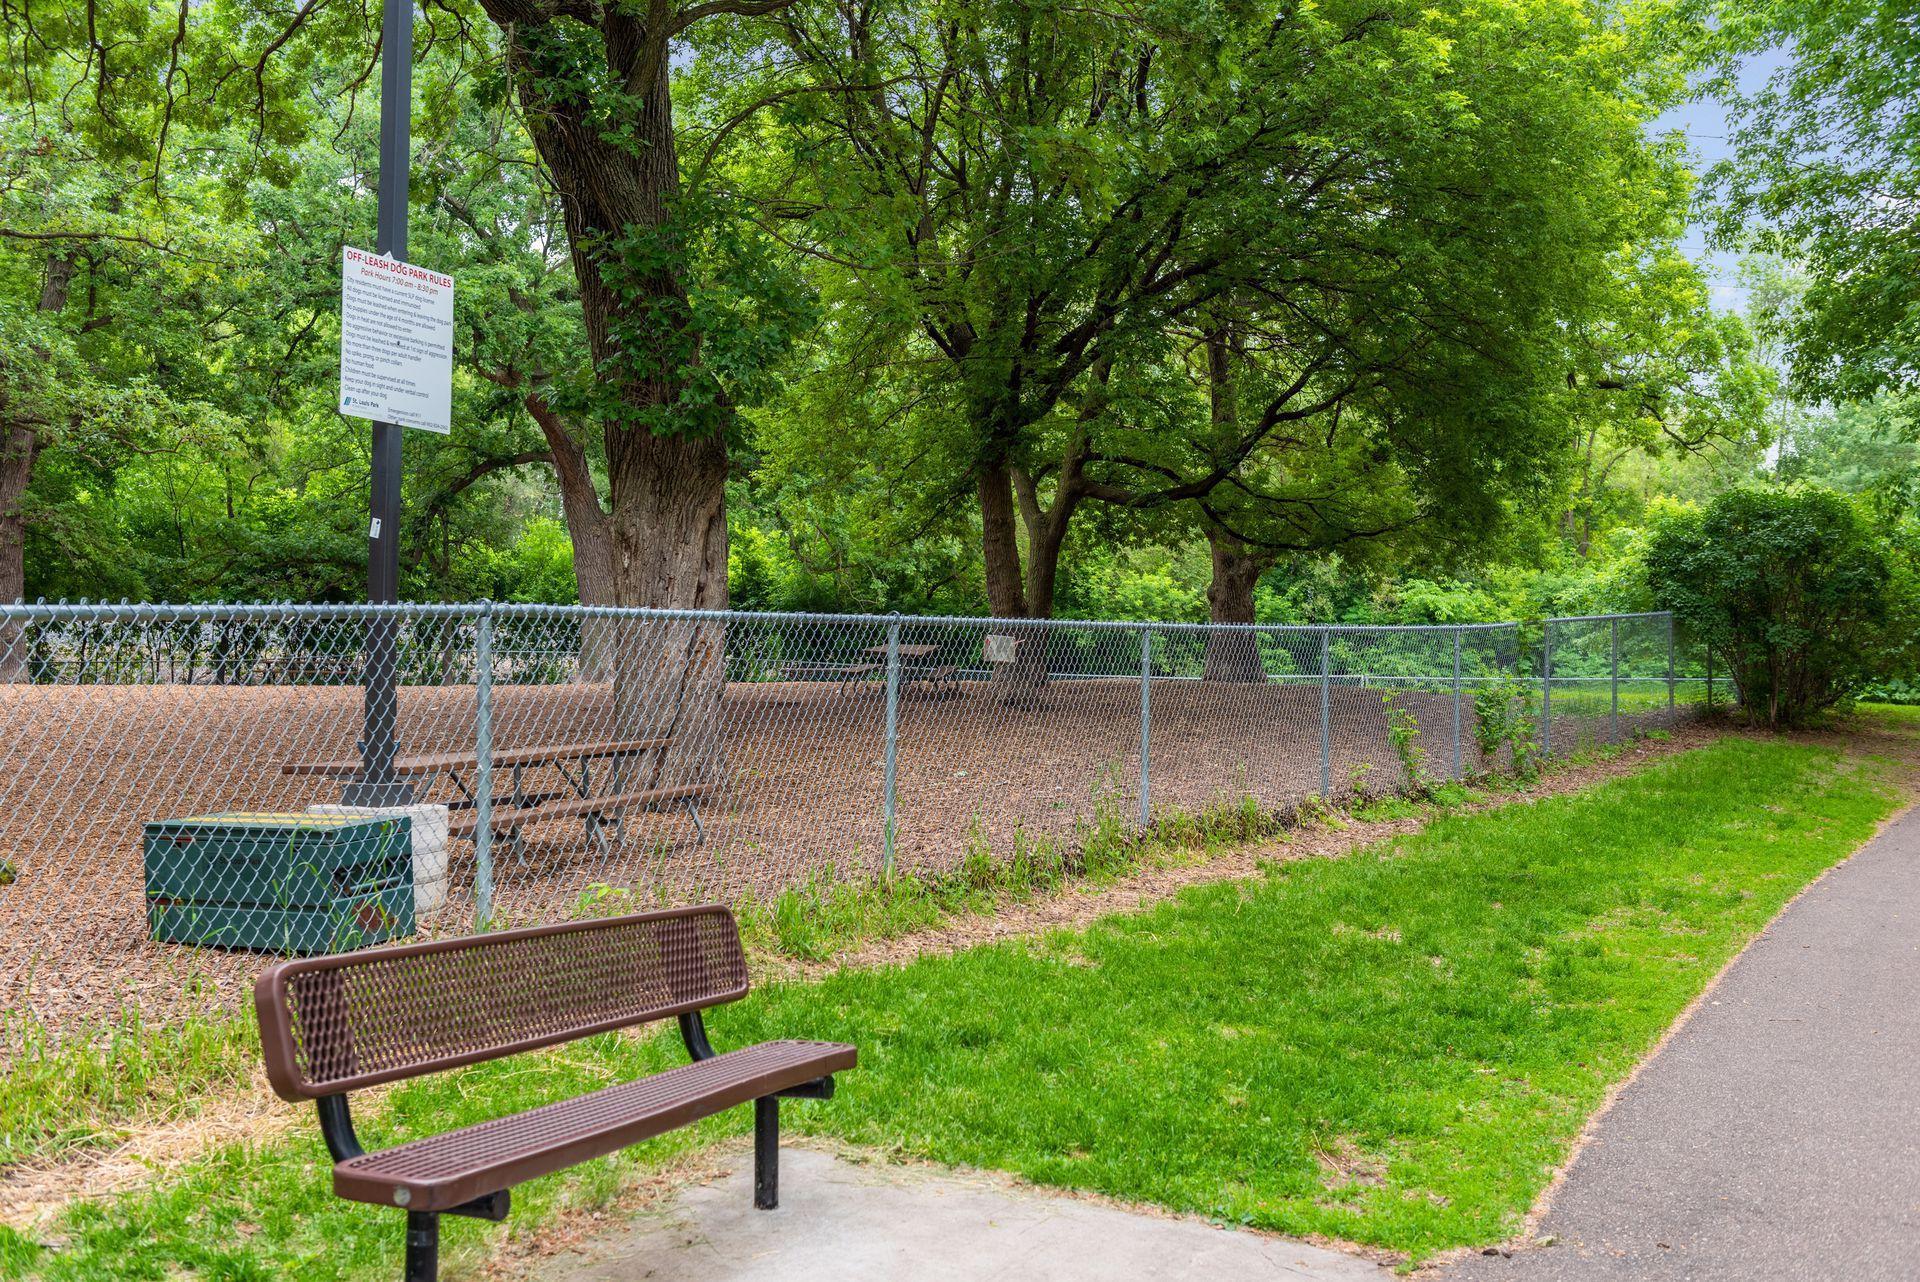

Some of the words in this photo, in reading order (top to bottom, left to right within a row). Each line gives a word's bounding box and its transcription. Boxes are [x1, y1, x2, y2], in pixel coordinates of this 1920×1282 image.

[347, 250, 389, 271] OFF-LEASH
[390, 262, 407, 276] DOG
[408, 267, 428, 282] PARK
[429, 273, 451, 288] RULES
[361, 267, 373, 278] Park
[374, 271, 391, 283] Hours
[392, 276, 404, 286] 7:00
[404, 281, 413, 289] am
[417, 283, 429, 293] 8:30
[429, 288, 438, 296] pm
